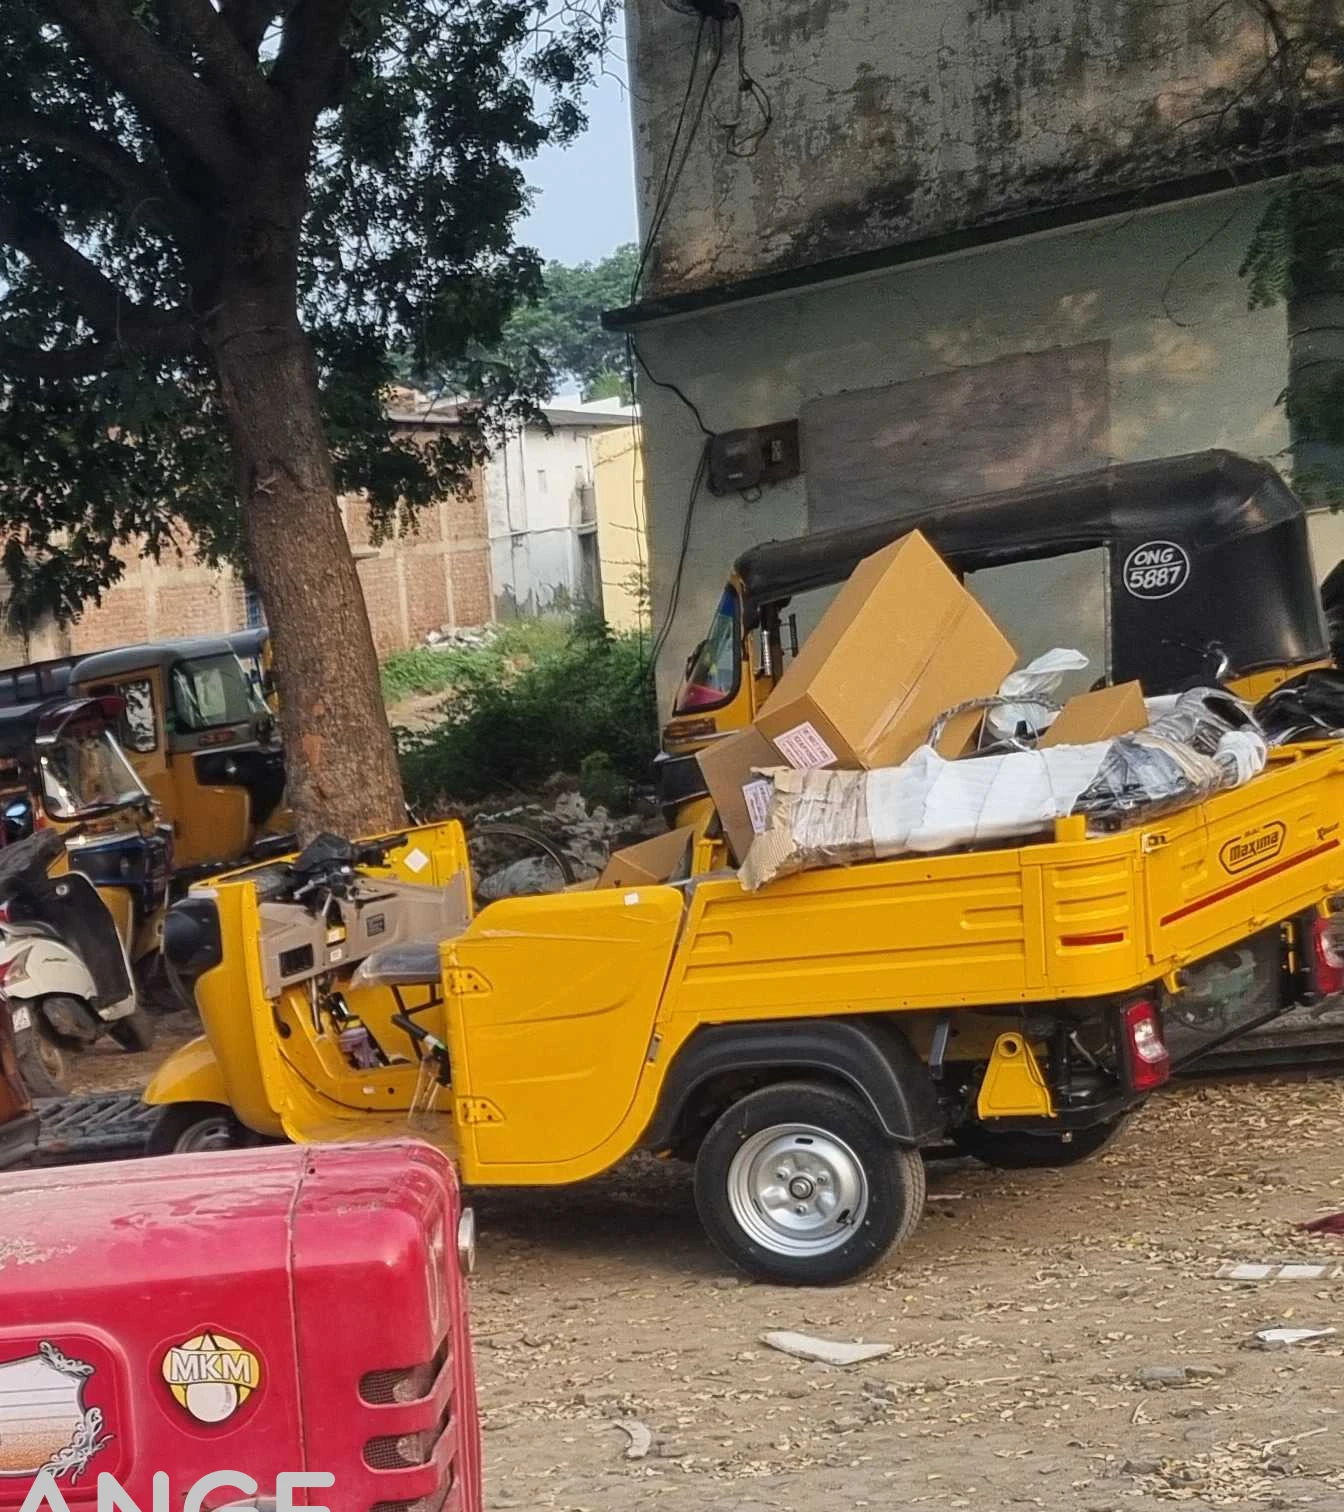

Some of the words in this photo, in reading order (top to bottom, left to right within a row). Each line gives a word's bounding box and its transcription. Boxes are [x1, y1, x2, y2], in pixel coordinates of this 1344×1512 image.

[1134, 547, 1175, 566] ONG
[1129, 565, 1182, 589] 5887
[1229, 831, 1280, 862] Maxima
[170, 1350, 252, 1385] MKM
